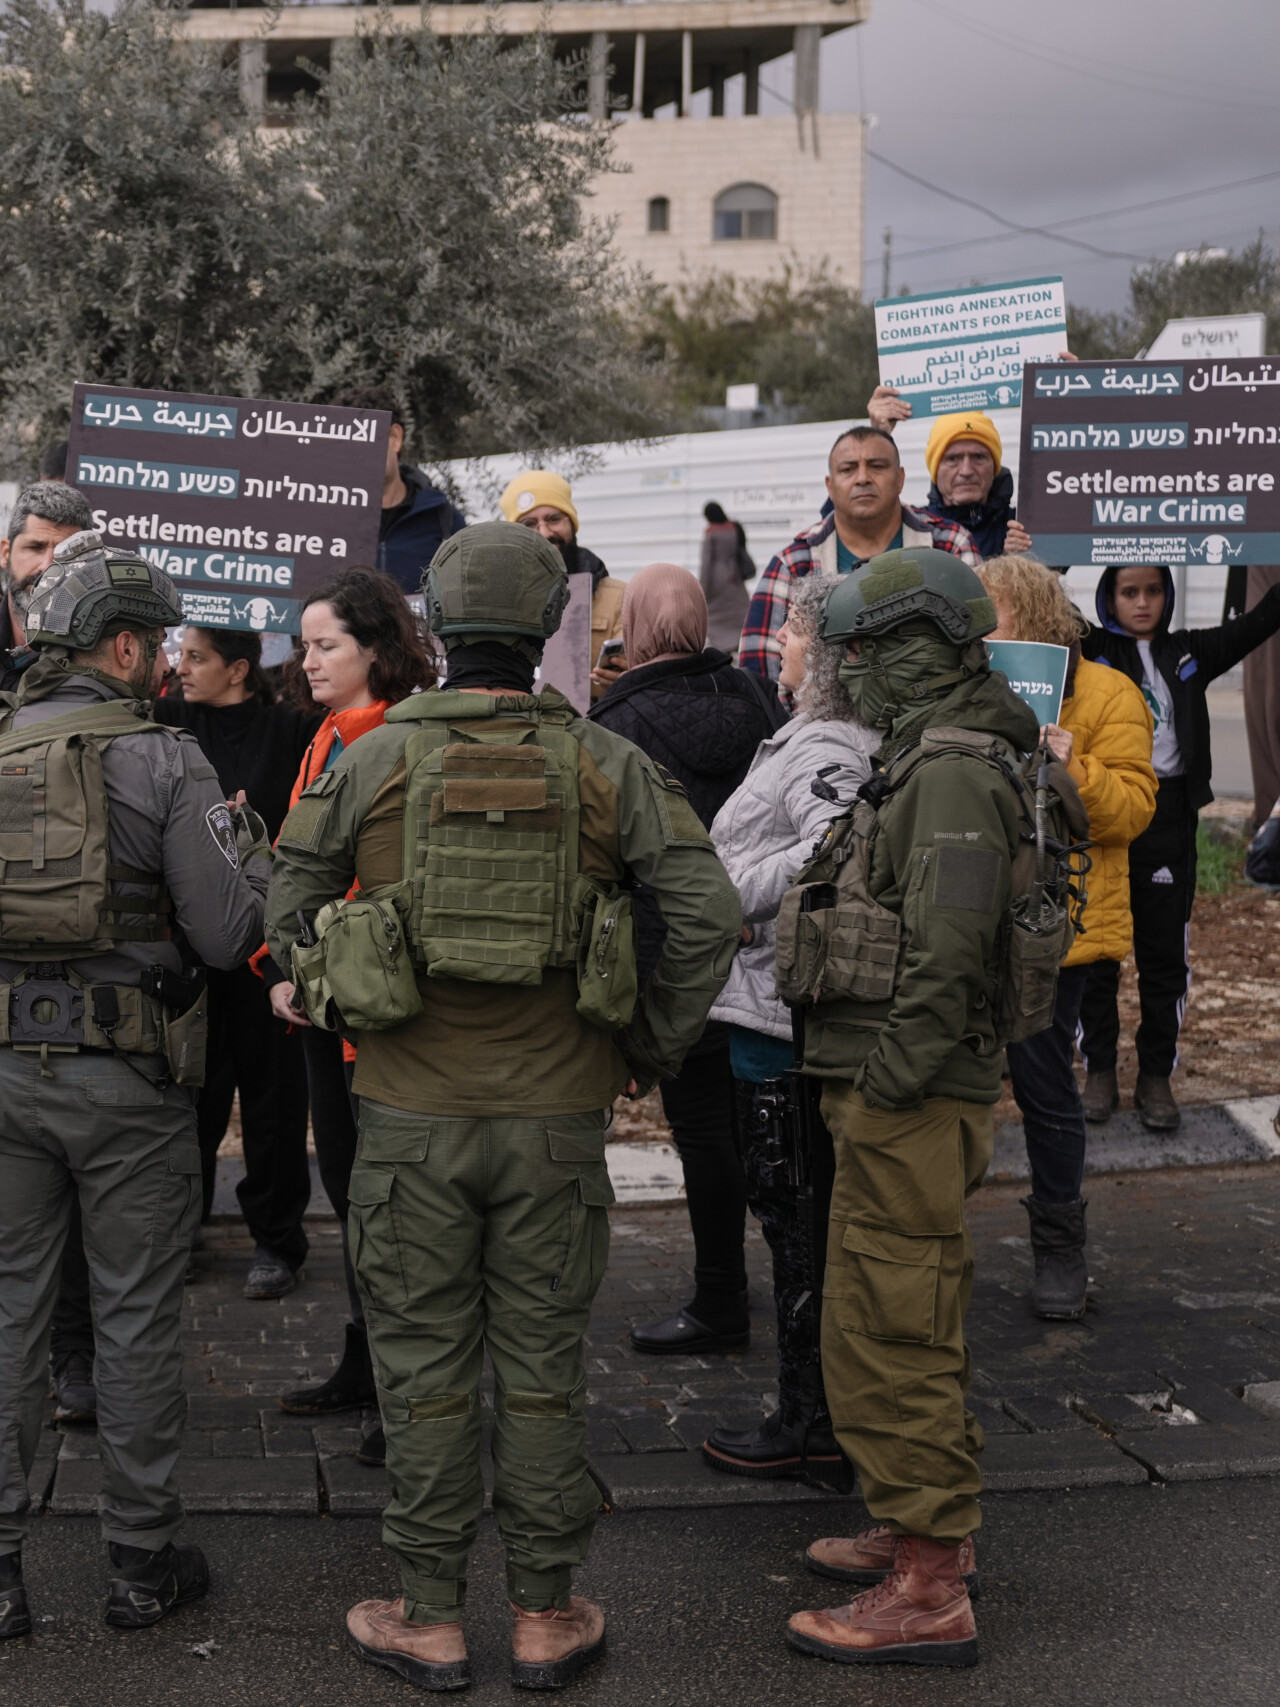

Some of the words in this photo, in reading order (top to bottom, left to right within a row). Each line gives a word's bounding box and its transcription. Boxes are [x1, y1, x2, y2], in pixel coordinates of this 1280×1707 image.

[887, 304, 954, 322] FIGHTING
[959, 290, 1052, 312] ANNEXATION
[880, 318, 978, 341] COMBATANTS
[982, 313, 1011, 328] FOR
[1015, 306, 1063, 323] PEACE
[1182, 328, 1238, 347] ירושלים
[925, 350, 965, 373] الضم
[968, 341, 1020, 365] نعارض
[883, 371, 933, 389] السلام
[970, 365, 995, 381] من
[1035, 374, 1092, 396] حرب
[1101, 368, 1180, 395] جريمة
[84, 401, 143, 426] حرب
[153, 401, 233, 437] جريمة
[242, 410, 377, 444] الاستيطان
[1032, 425, 1121, 448] מלחמה
[1128, 428, 1186, 448] פשע
[1194, 421, 1280, 445] נחליות
[78, 461, 169, 489] מלחמה
[177, 471, 236, 495] פשע
[1046, 469, 1220, 494] Settlements
[1227, 473, 1275, 492] are
[243, 475, 369, 507] התנחליות
[1094, 500, 1152, 523] War
[1158, 498, 1245, 522] Crime
[91, 509, 268, 550] Settlements
[275, 532, 324, 555] are
[329, 537, 347, 557] a
[138, 546, 198, 577] War
[203, 553, 293, 586] Crime
[1091, 554, 1144, 563] COMBATANTS
[1144, 554, 1160, 562] FOR
[1160, 554, 1186, 562] PEACE
[182, 593, 231, 605] לוחמים
[186, 612, 203, 622] FOR
[203, 614, 230, 625] PEACE
[1008, 680, 1054, 696] מערכ
